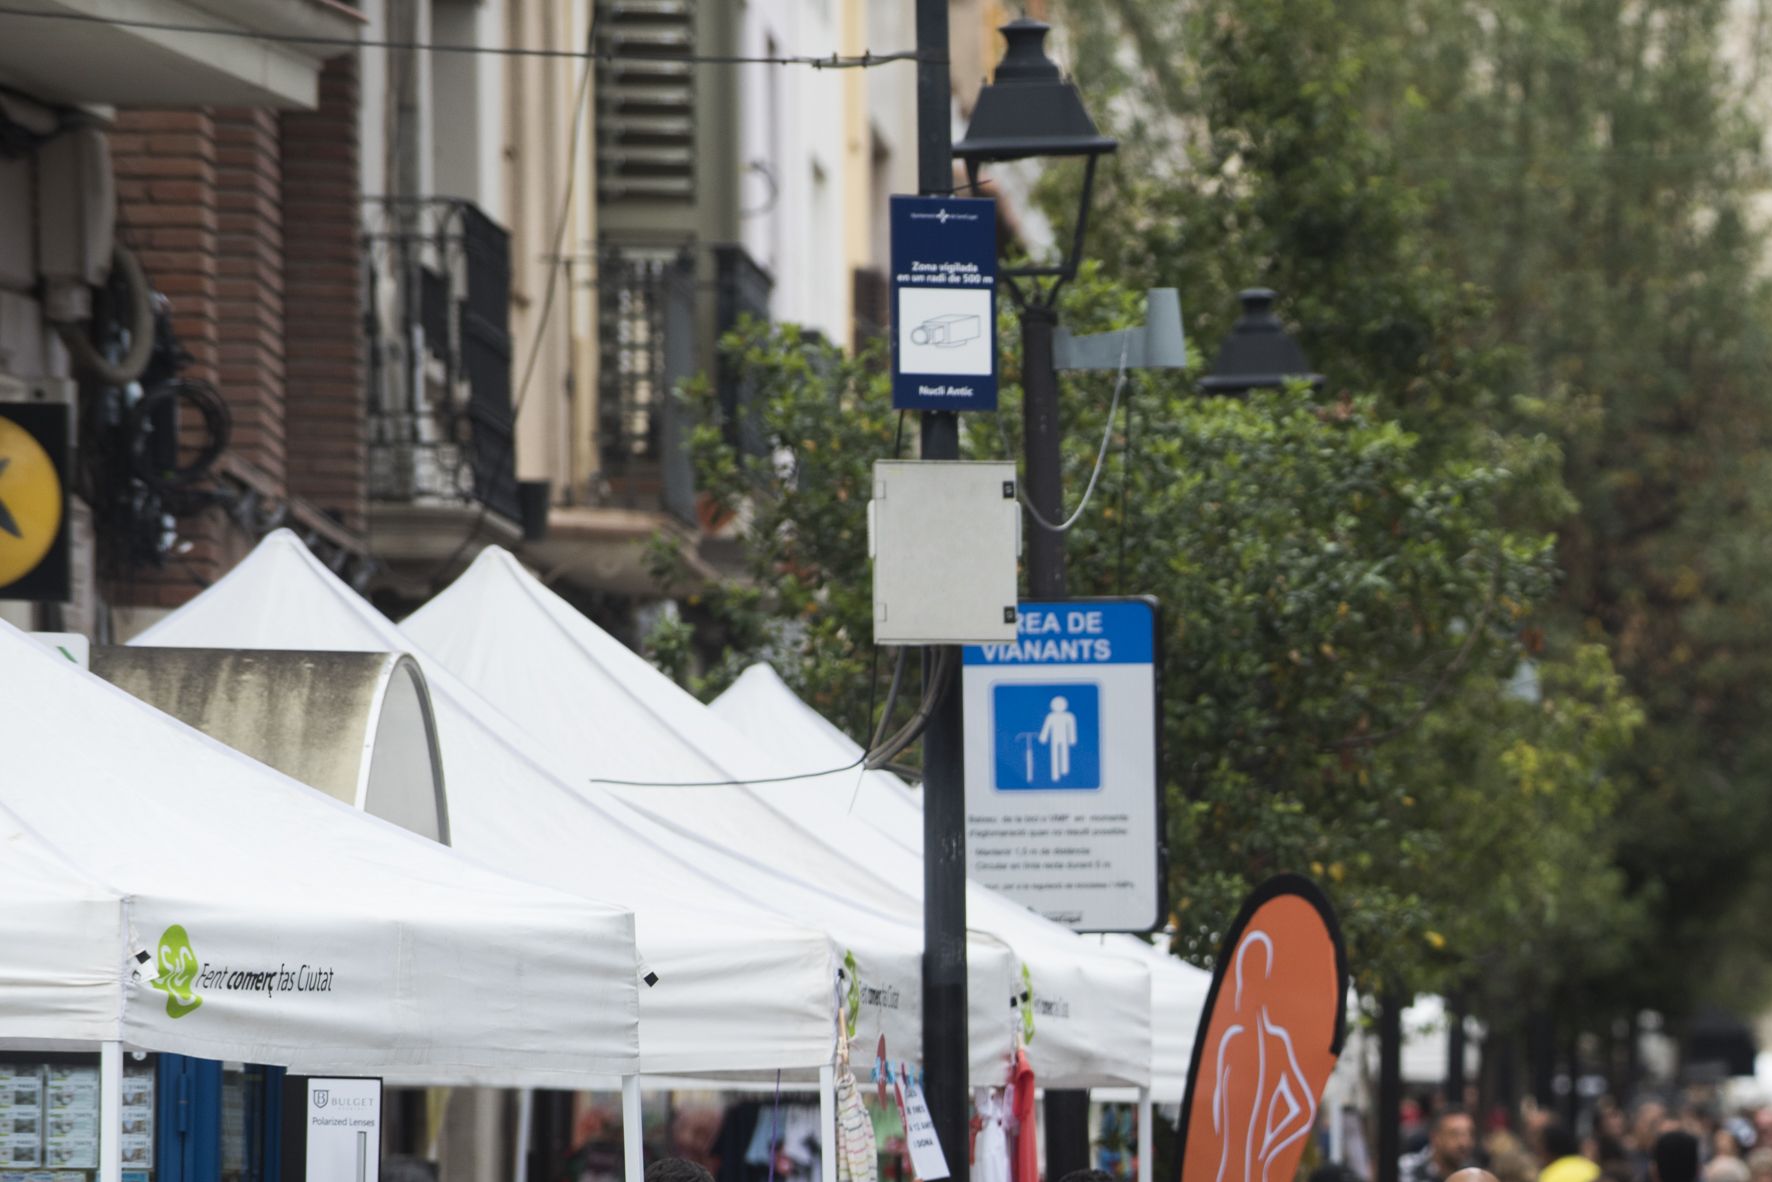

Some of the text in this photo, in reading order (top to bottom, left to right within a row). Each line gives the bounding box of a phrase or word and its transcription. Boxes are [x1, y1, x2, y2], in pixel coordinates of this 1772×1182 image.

[911, 261, 979, 274] Zona vigilada
[896, 273, 994, 284] en un radi de 500 m
[918, 385, 974, 397] Nucli Antic
[1015, 611, 1061, 635] REA
[1067, 611, 1103, 634] DE
[981, 638, 1112, 662] VIANANTS
[196, 963, 229, 990] Fent
[226, 969, 277, 999] comerç
[275, 963, 296, 992] fas
[297, 964, 334, 992] Ciutat
[331, 1097, 374, 1106] BULGET
[312, 1116, 375, 1127] Polarized Lenses
